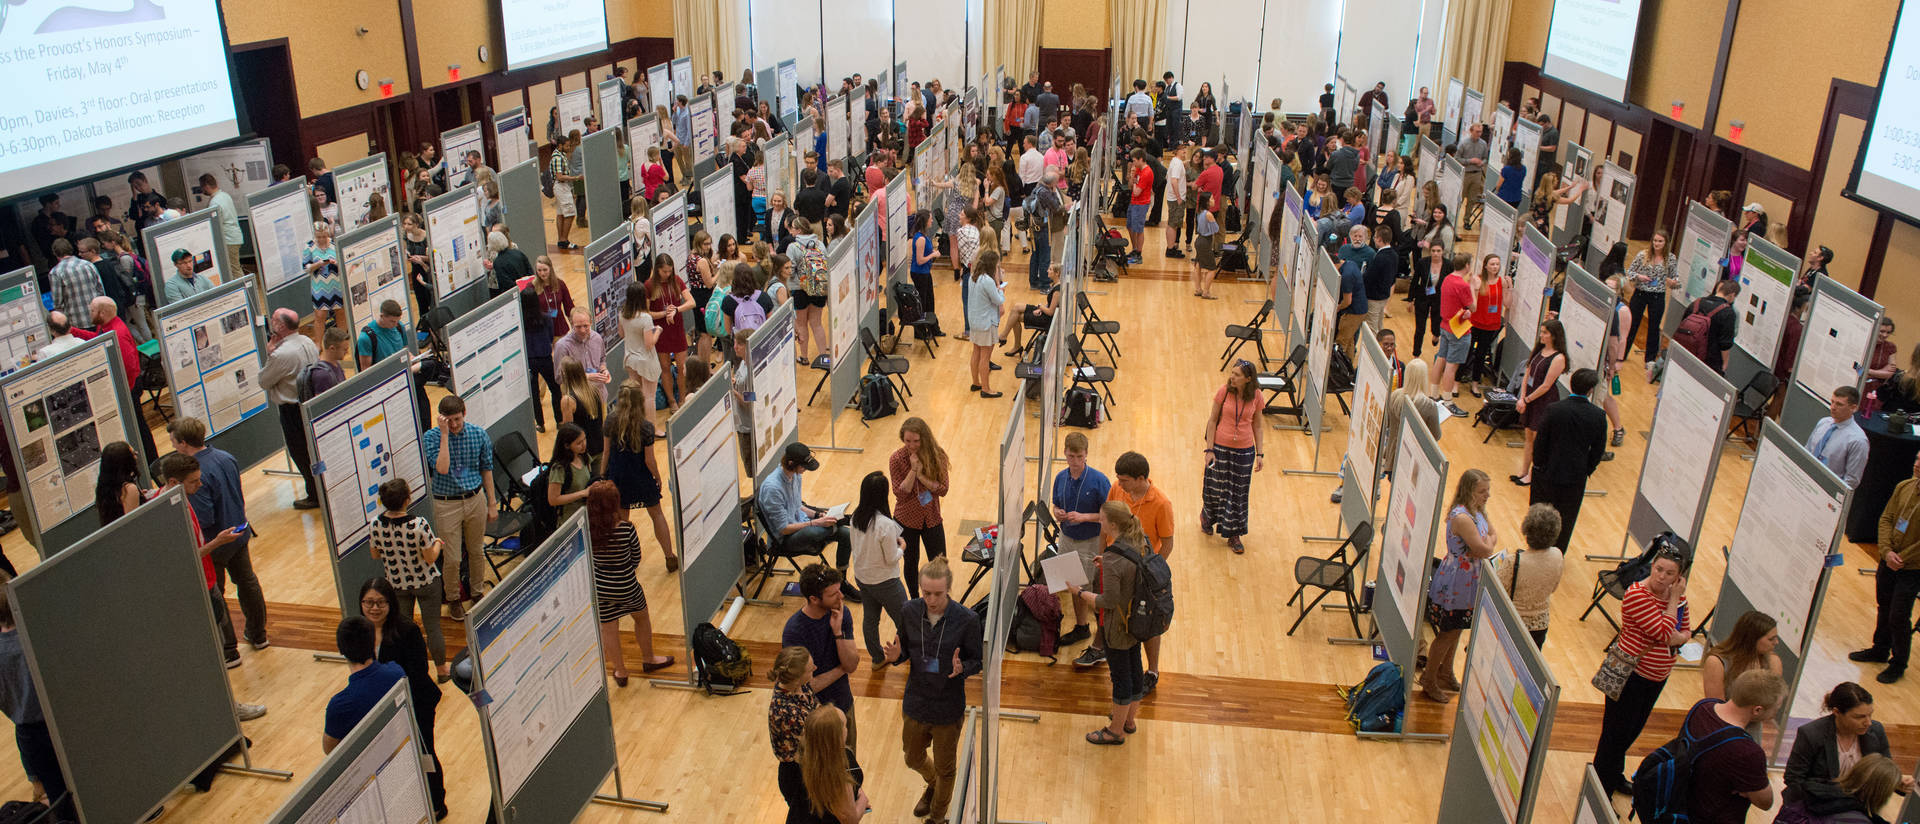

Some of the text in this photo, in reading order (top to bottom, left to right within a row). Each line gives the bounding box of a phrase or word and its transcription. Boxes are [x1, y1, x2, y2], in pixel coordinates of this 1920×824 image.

[15, 46, 36, 62] the
[38, 37, 92, 58] Provost's
[94, 33, 133, 50] Honors
[135, 26, 192, 46] Symposium
[46, 55, 129, 82] Friday, May 4th
[35, 106, 79, 124] Davies,
[81, 98, 97, 115] 3rd
[98, 96, 129, 112] floor:
[130, 89, 152, 105] Oral
[154, 79, 218, 102] presentations
[63, 123, 104, 143] Dakota
[106, 113, 157, 133] Ballroom:
[158, 102, 205, 122] Reception
